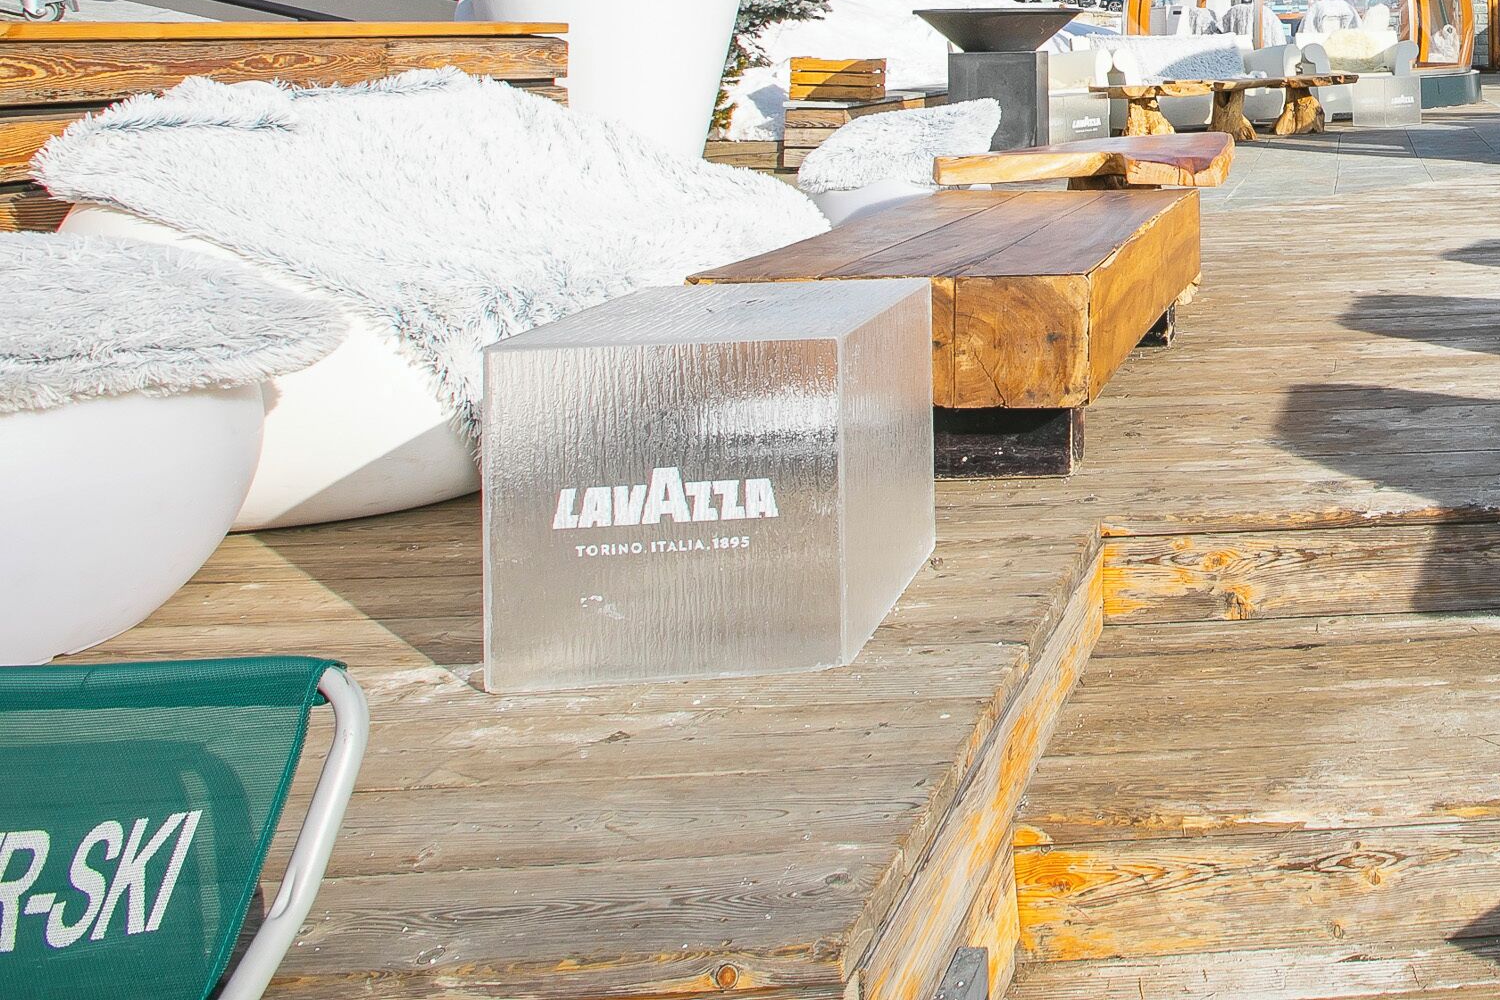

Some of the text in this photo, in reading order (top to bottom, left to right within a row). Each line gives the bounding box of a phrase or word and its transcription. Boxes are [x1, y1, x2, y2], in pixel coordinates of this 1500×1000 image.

[552, 466, 780, 530] LAVAZZA
[712, 535, 750, 550] 1895
[0, 810, 203, 952] R-SKI
